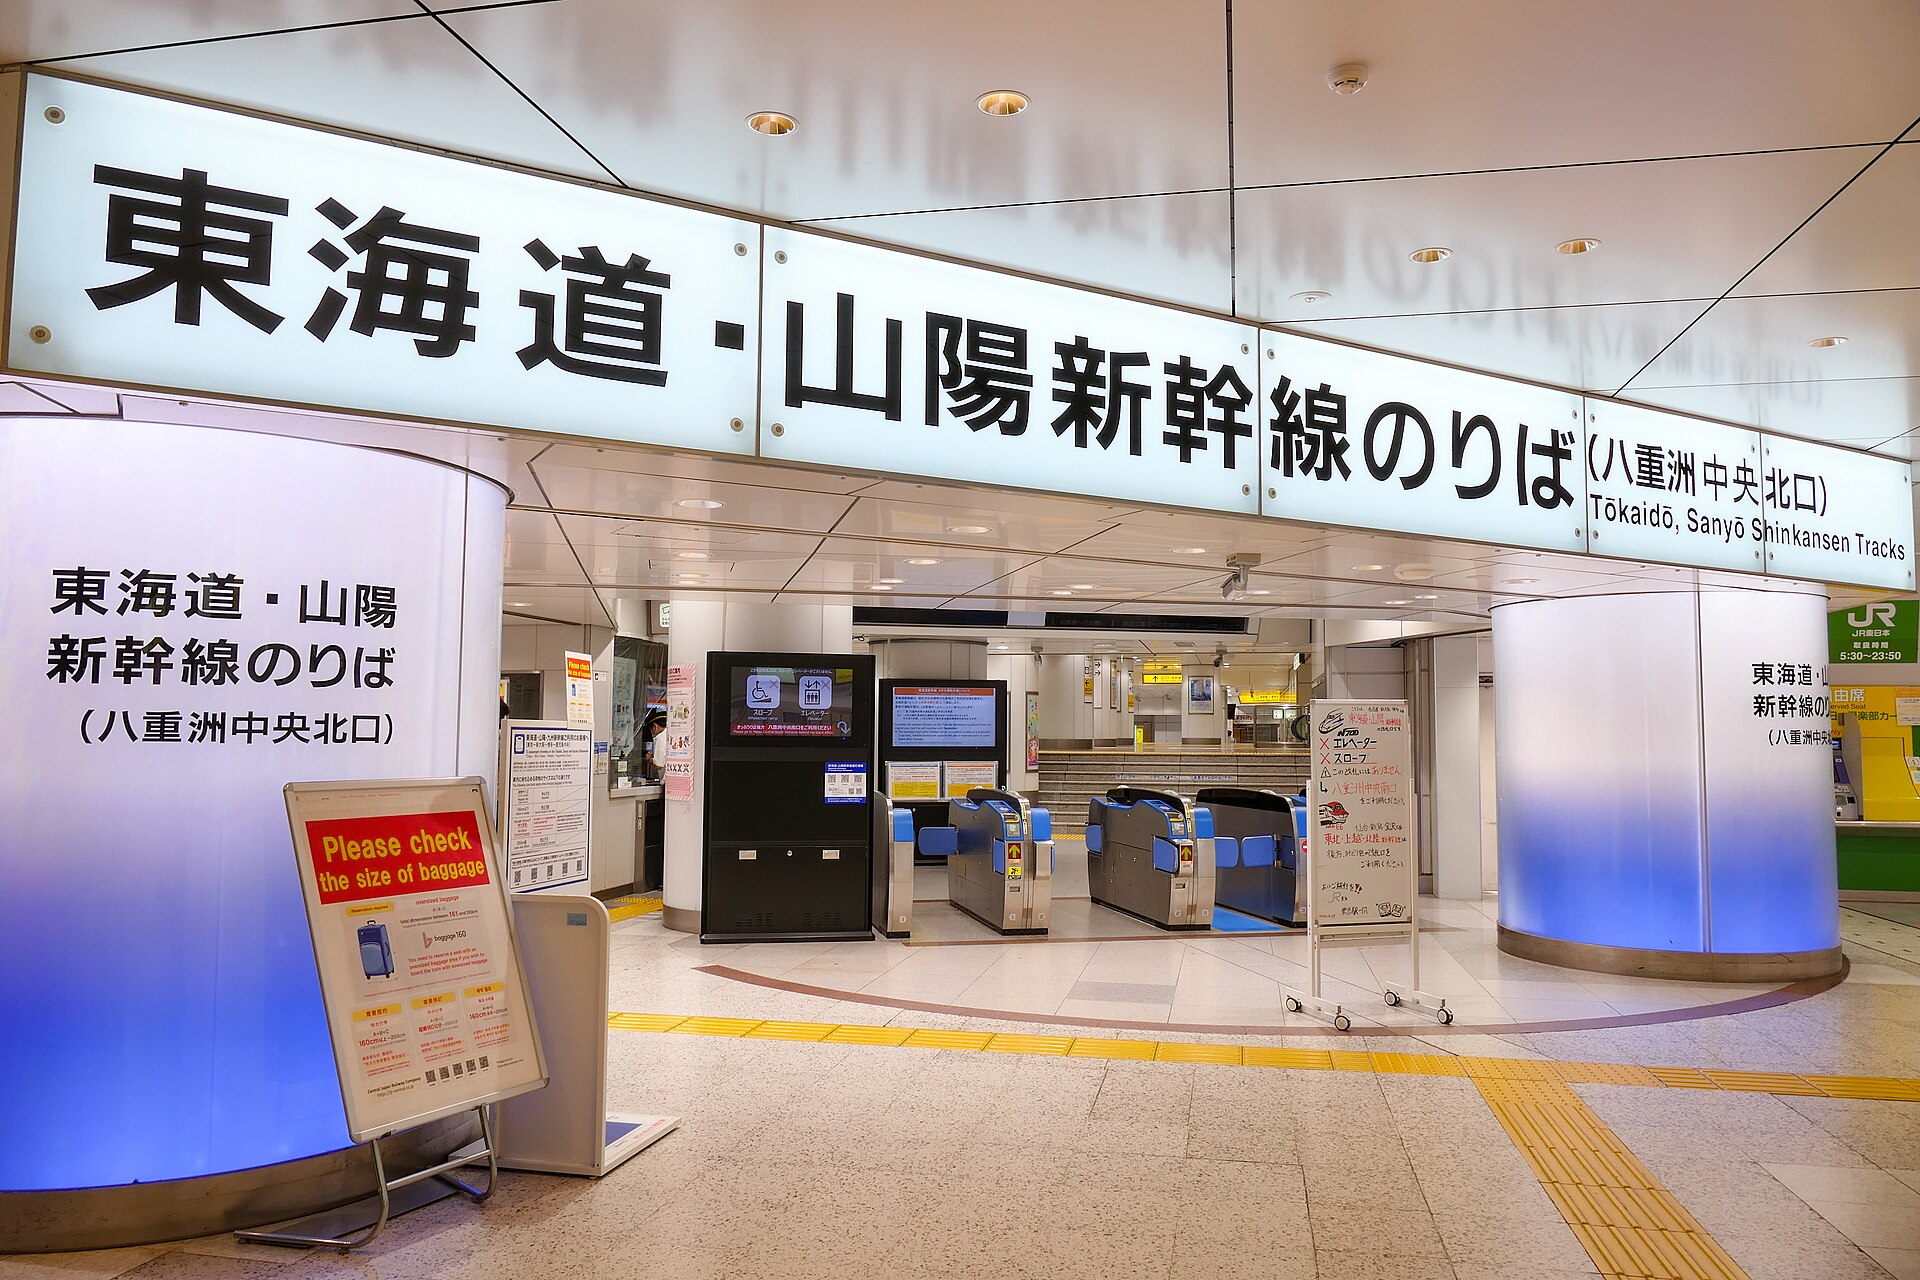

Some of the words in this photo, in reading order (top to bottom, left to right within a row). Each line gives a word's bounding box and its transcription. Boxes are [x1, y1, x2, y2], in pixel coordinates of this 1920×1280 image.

[84, 163, 1575, 510] 東海道・山陽新幹線のりば
[1588, 433, 1828, 517] (八重洲中央北口)
[1590, 493, 1679, 535] Tōkaidō,
[1687, 506, 1745, 543] Sanyō
[1752, 517, 1850, 554] Shinkansen
[1855, 532, 1906, 561] Tracks
[50, 566, 398, 629] 東海道・山陽
[1847, 602, 1897, 628] JR
[1852, 629, 1890, 637] JR東日本
[46, 633, 396, 689] 新幹線のりば
[80, 708, 394, 744] (八重洲中央北口)
[322, 835, 402, 863] Please
[409, 826, 473, 855] check
[319, 871, 350, 893] the
[356, 867, 391, 889] size
[397, 863, 414, 884] of
[418, 859, 486, 882] baggage
[416, 897, 439, 906] oversized
[439, 894, 459, 903] baggage
